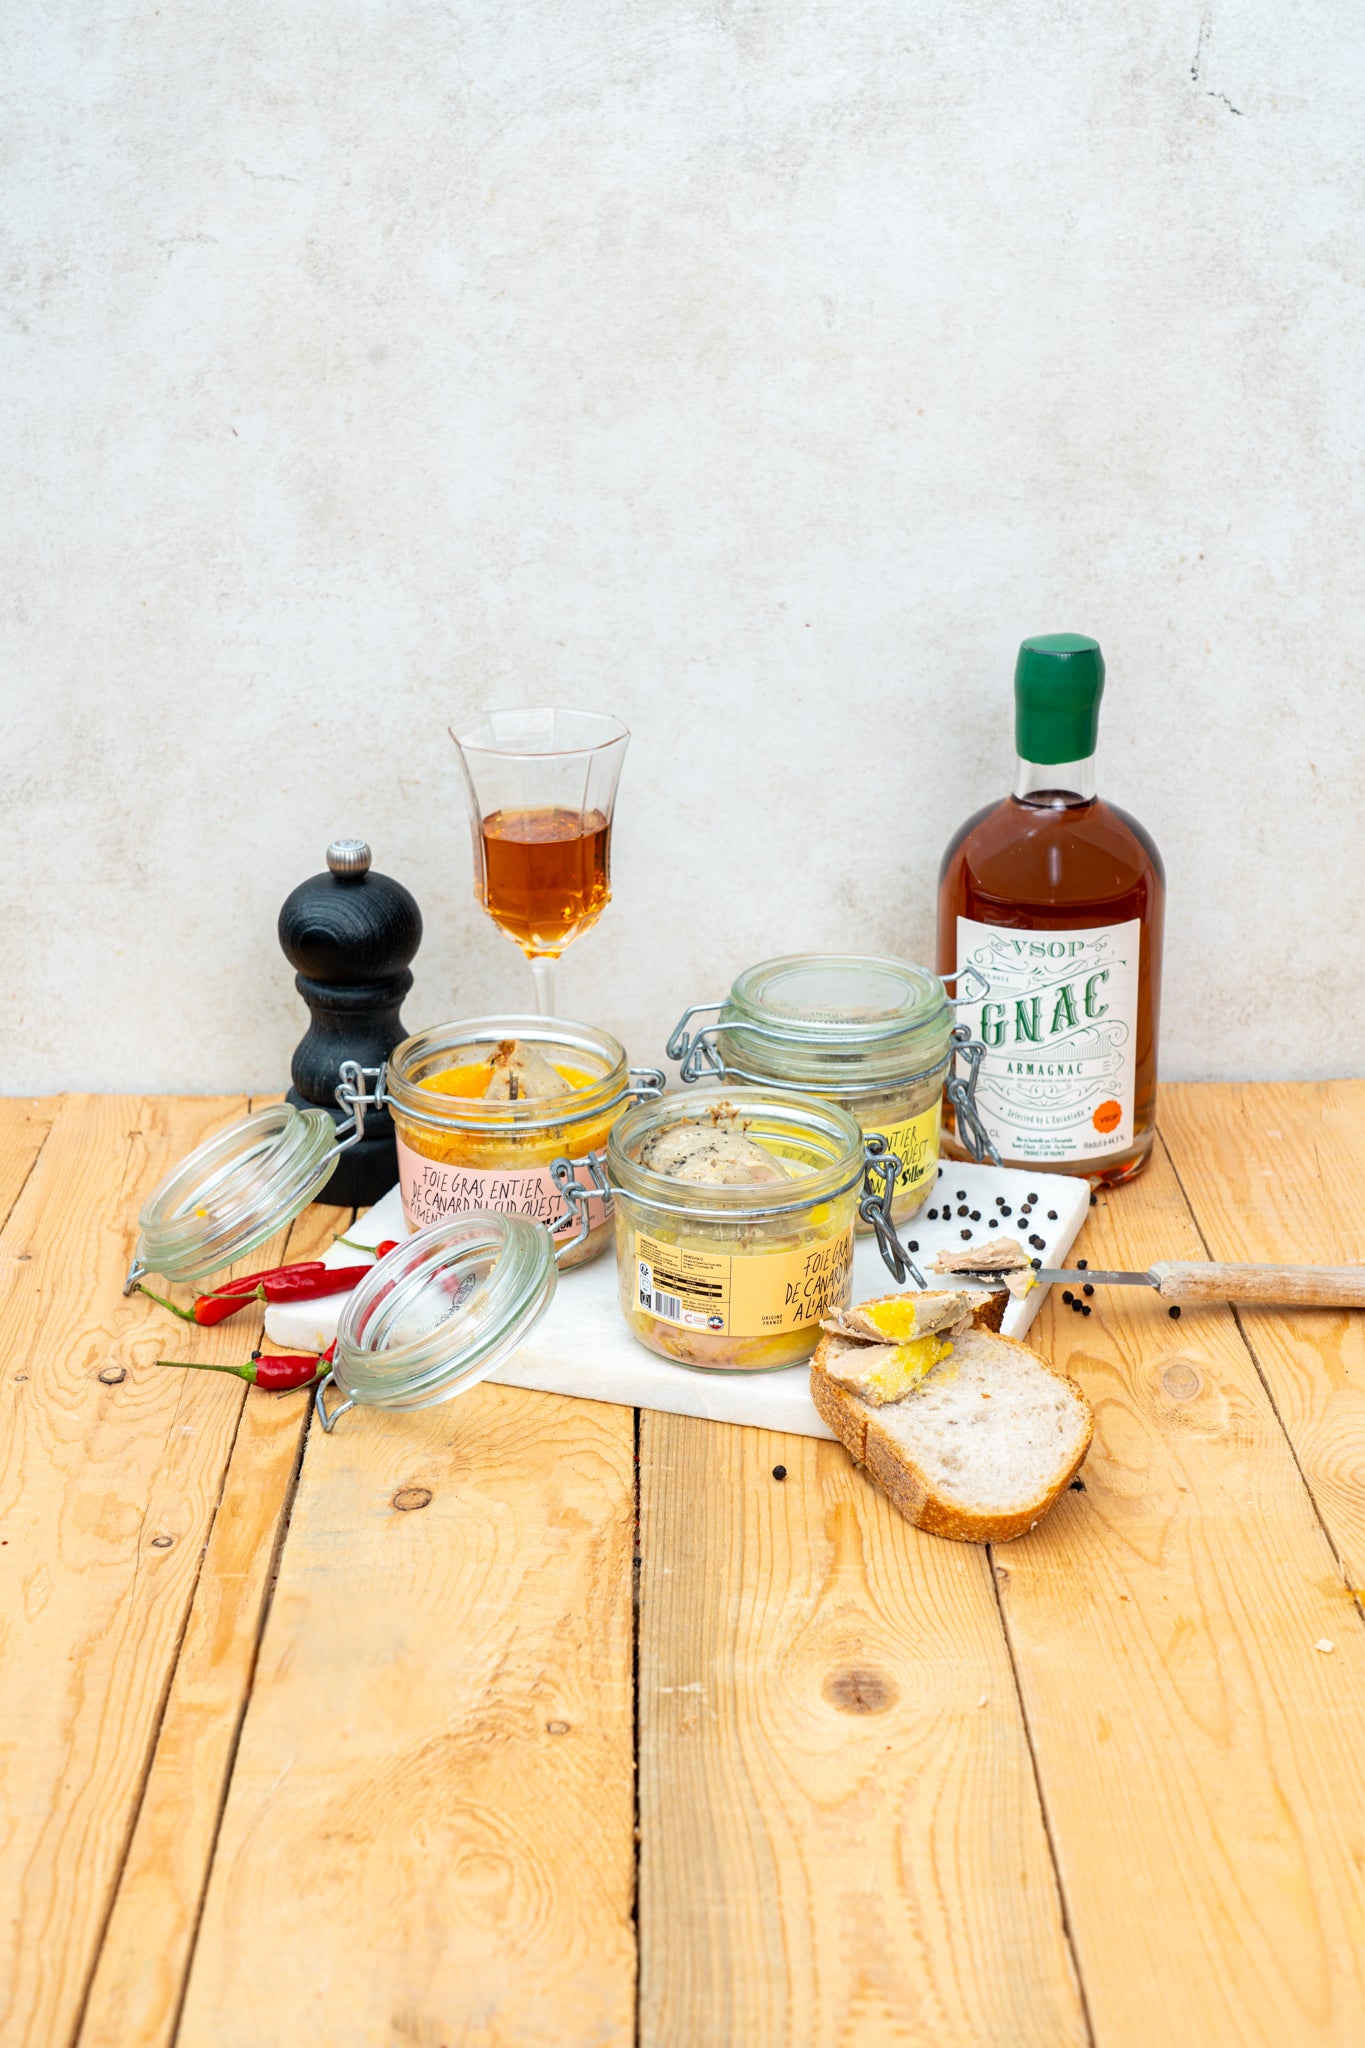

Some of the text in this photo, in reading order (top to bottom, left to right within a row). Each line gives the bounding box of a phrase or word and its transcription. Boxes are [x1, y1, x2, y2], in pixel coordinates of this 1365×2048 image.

[1011, 939, 1085, 959] VSOP
[981, 969, 1110, 1048] GNAC
[1007, 1062, 1084, 1076] ARMAGNAC
[1007, 1108, 1034, 1123] Selected
[1036, 1114, 1043, 1125] by
[1100, 1113, 1119, 1123] VSOP
[886, 1126, 917, 1152] NTIER
[422, 1166, 545, 1200] FOIE GRAS ENTIER
[413, 1180, 422, 1203] DE
[425, 1189, 470, 1214] CANARD
[521, 1194, 563, 1217] OUEST
[803, 1249, 831, 1277] FOIE
[785, 1282, 801, 1305] DE
[804, 1262, 842, 1297] CANARD
[792, 1303, 803, 1322] A
